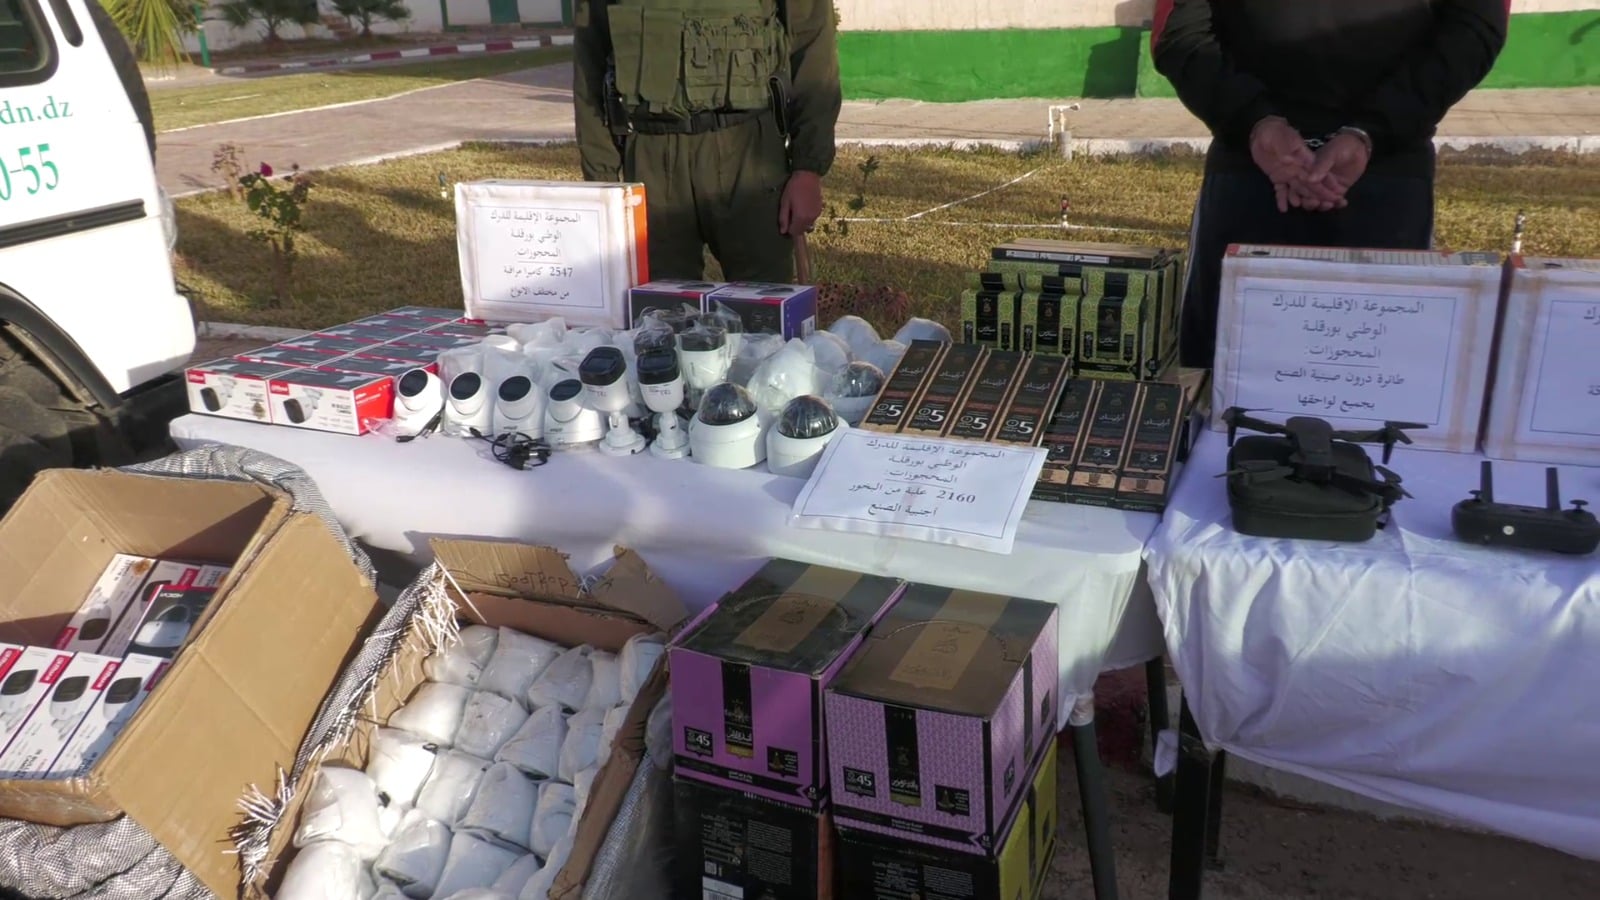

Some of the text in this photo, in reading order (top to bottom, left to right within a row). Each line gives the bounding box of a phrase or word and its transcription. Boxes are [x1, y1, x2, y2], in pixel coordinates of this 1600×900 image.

[490, 209, 511, 223] للدرك
[545, 212, 581, 225] المجموعة
[511, 228, 561, 243] الوطني بورقلة
[504, 265, 573, 278] 2547 كاميرا مراقبة
[533, 287, 557, 296] مختلف
[560, 291, 570, 300] من
[1272, 294, 1306, 311] للدرك
[1363, 301, 1424, 317] المجموعة
[1303, 320, 1387, 341] الوطني بورقلة
[1274, 368, 1306, 382] الصنع
[1345, 373, 1372, 386] درون
[1377, 373, 1405, 388] طائرة
[888, 403, 903, 417] 5
[1298, 394, 1375, 412] بجميع لواحقها
[929, 409, 945, 422] 5
[972, 415, 988, 430] 5
[1016, 420, 1034, 434] 5
[866, 439, 899, 450] للدرك
[949, 447, 1005, 459] المجموعة
[888, 454, 967, 471] الوطني بورقلة
[849, 482, 976, 504] 2160 علبة من البخور
[868, 502, 938, 517] أجنبية الصنع
[696, 734, 710, 747] 45
[856, 774, 872, 787] 45
